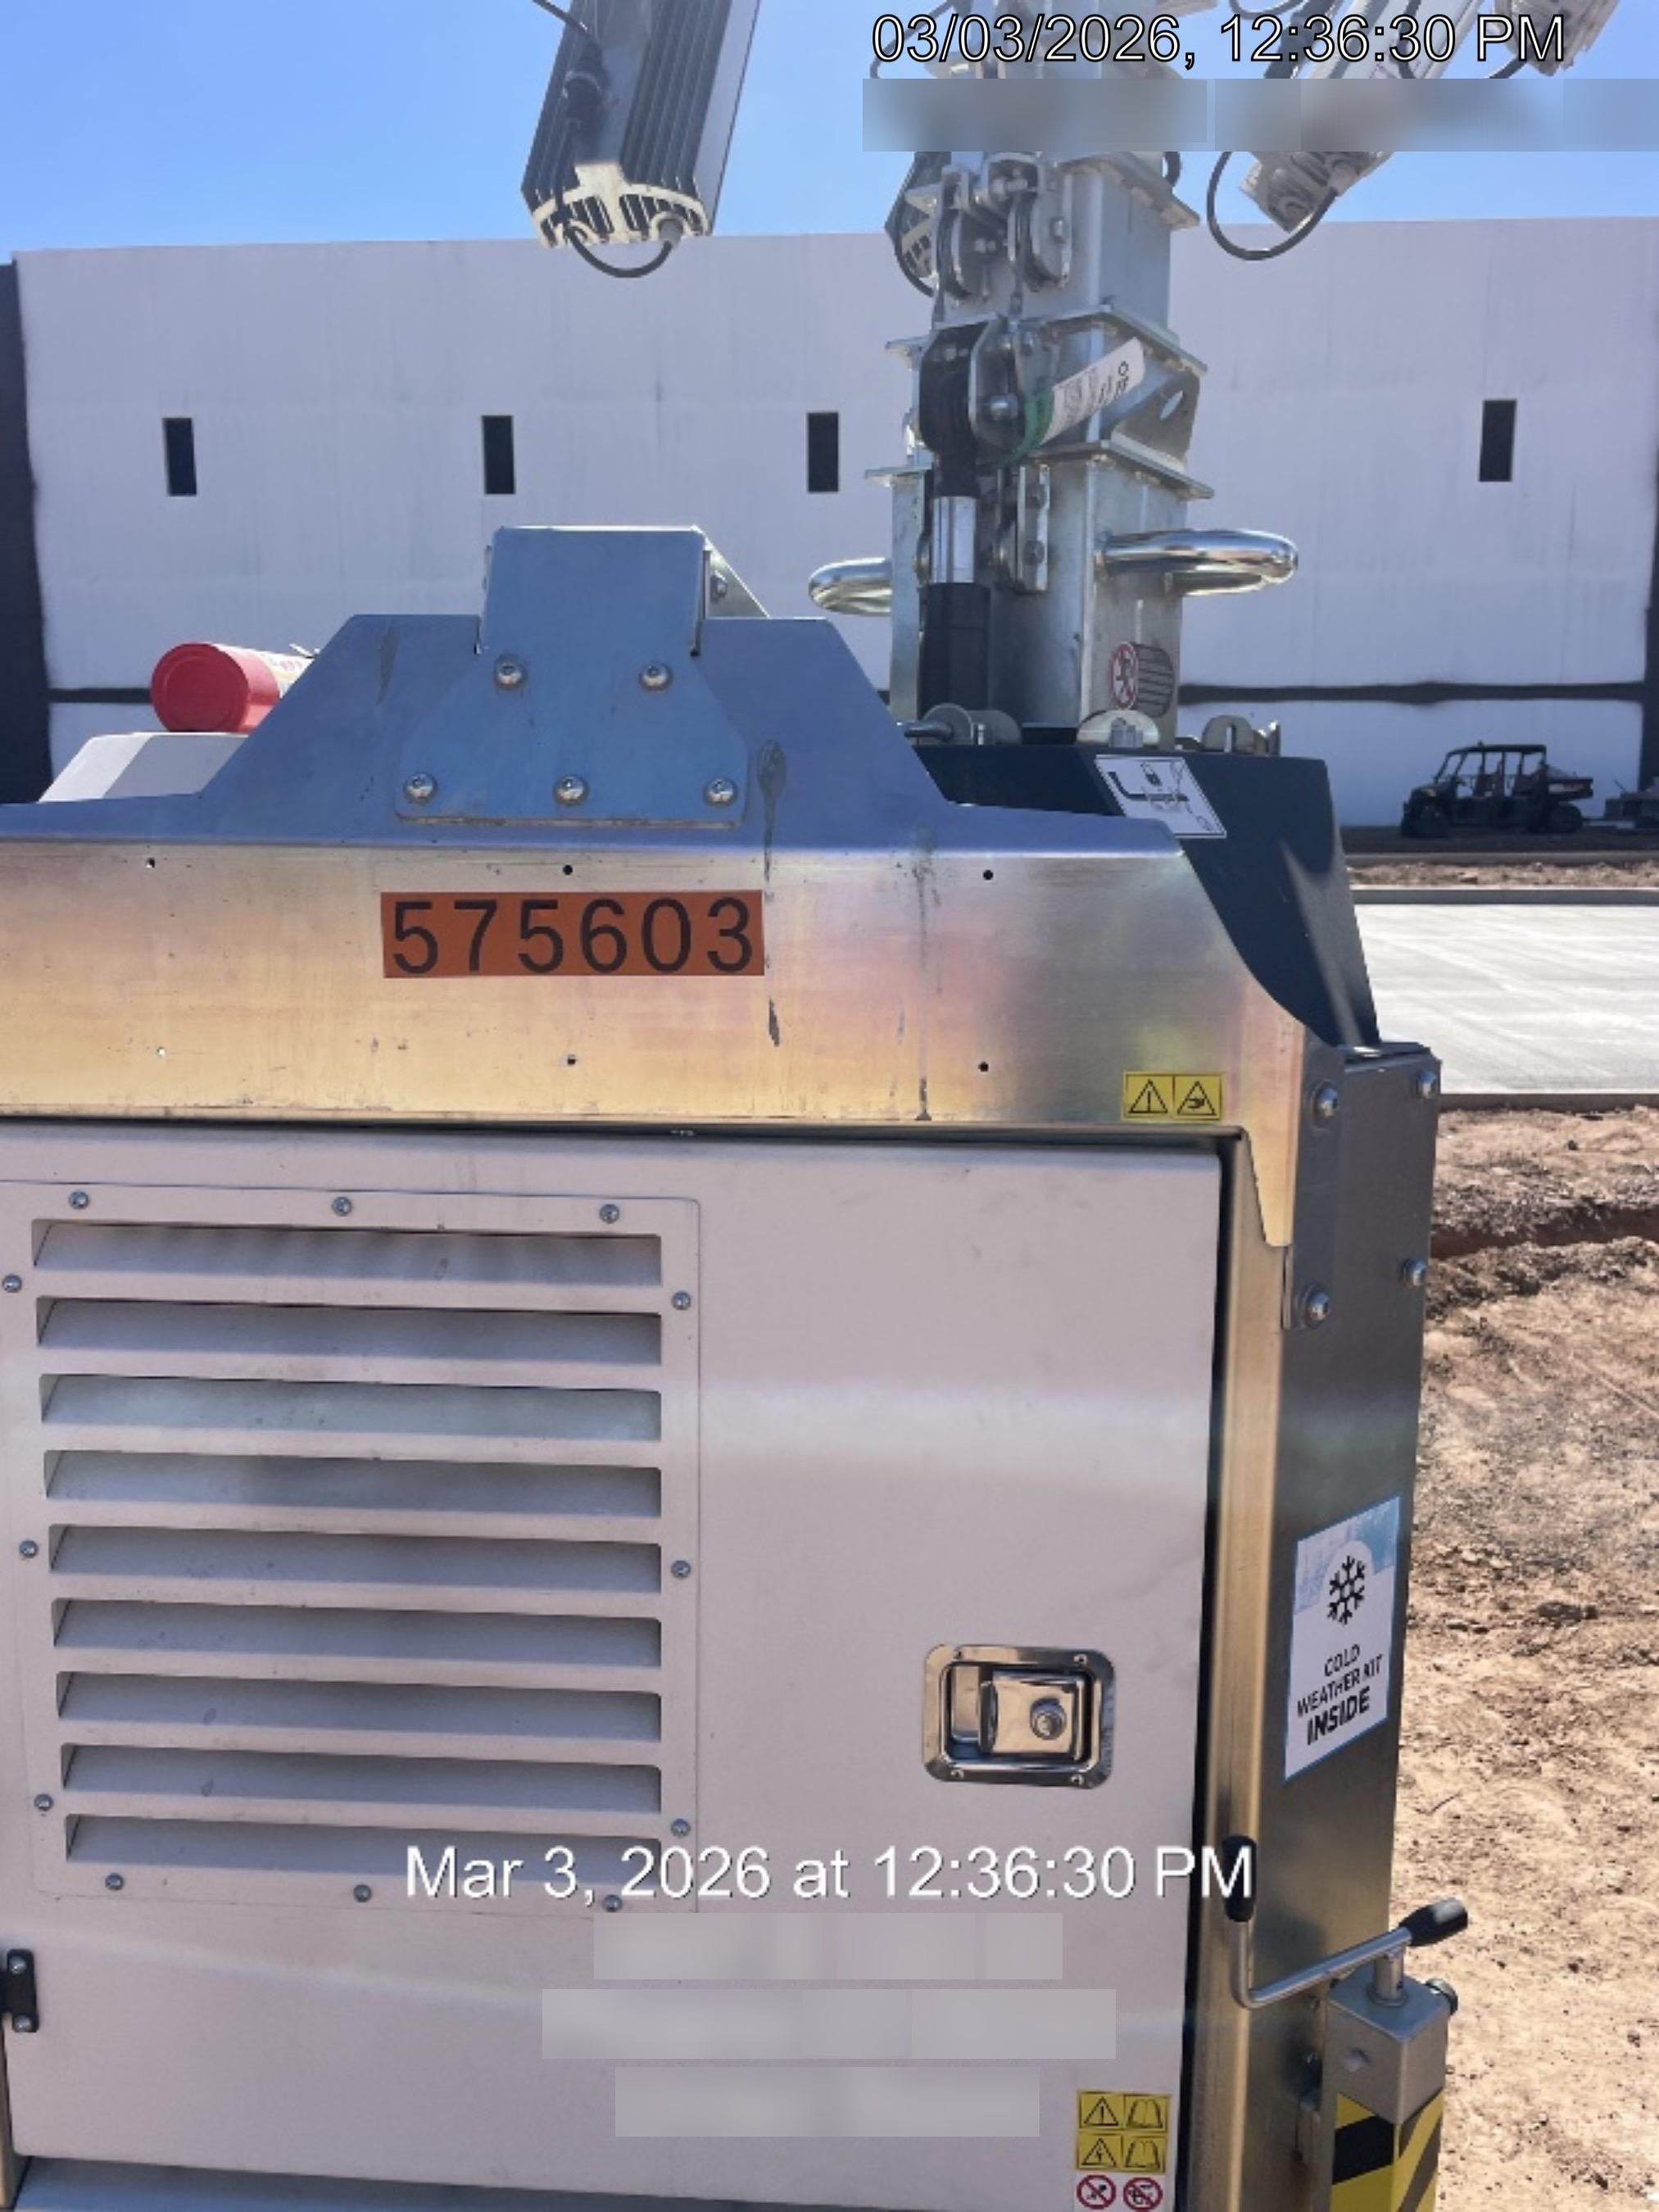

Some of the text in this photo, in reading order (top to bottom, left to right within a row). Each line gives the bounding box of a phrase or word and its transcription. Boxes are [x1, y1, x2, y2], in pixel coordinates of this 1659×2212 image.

[392, 897, 752, 973] 575603
[1324, 1643, 1360, 1676] COLD
[1297, 1669, 1360, 1717] WEATHER
[1307, 1685, 1370, 1747] INSIDE
